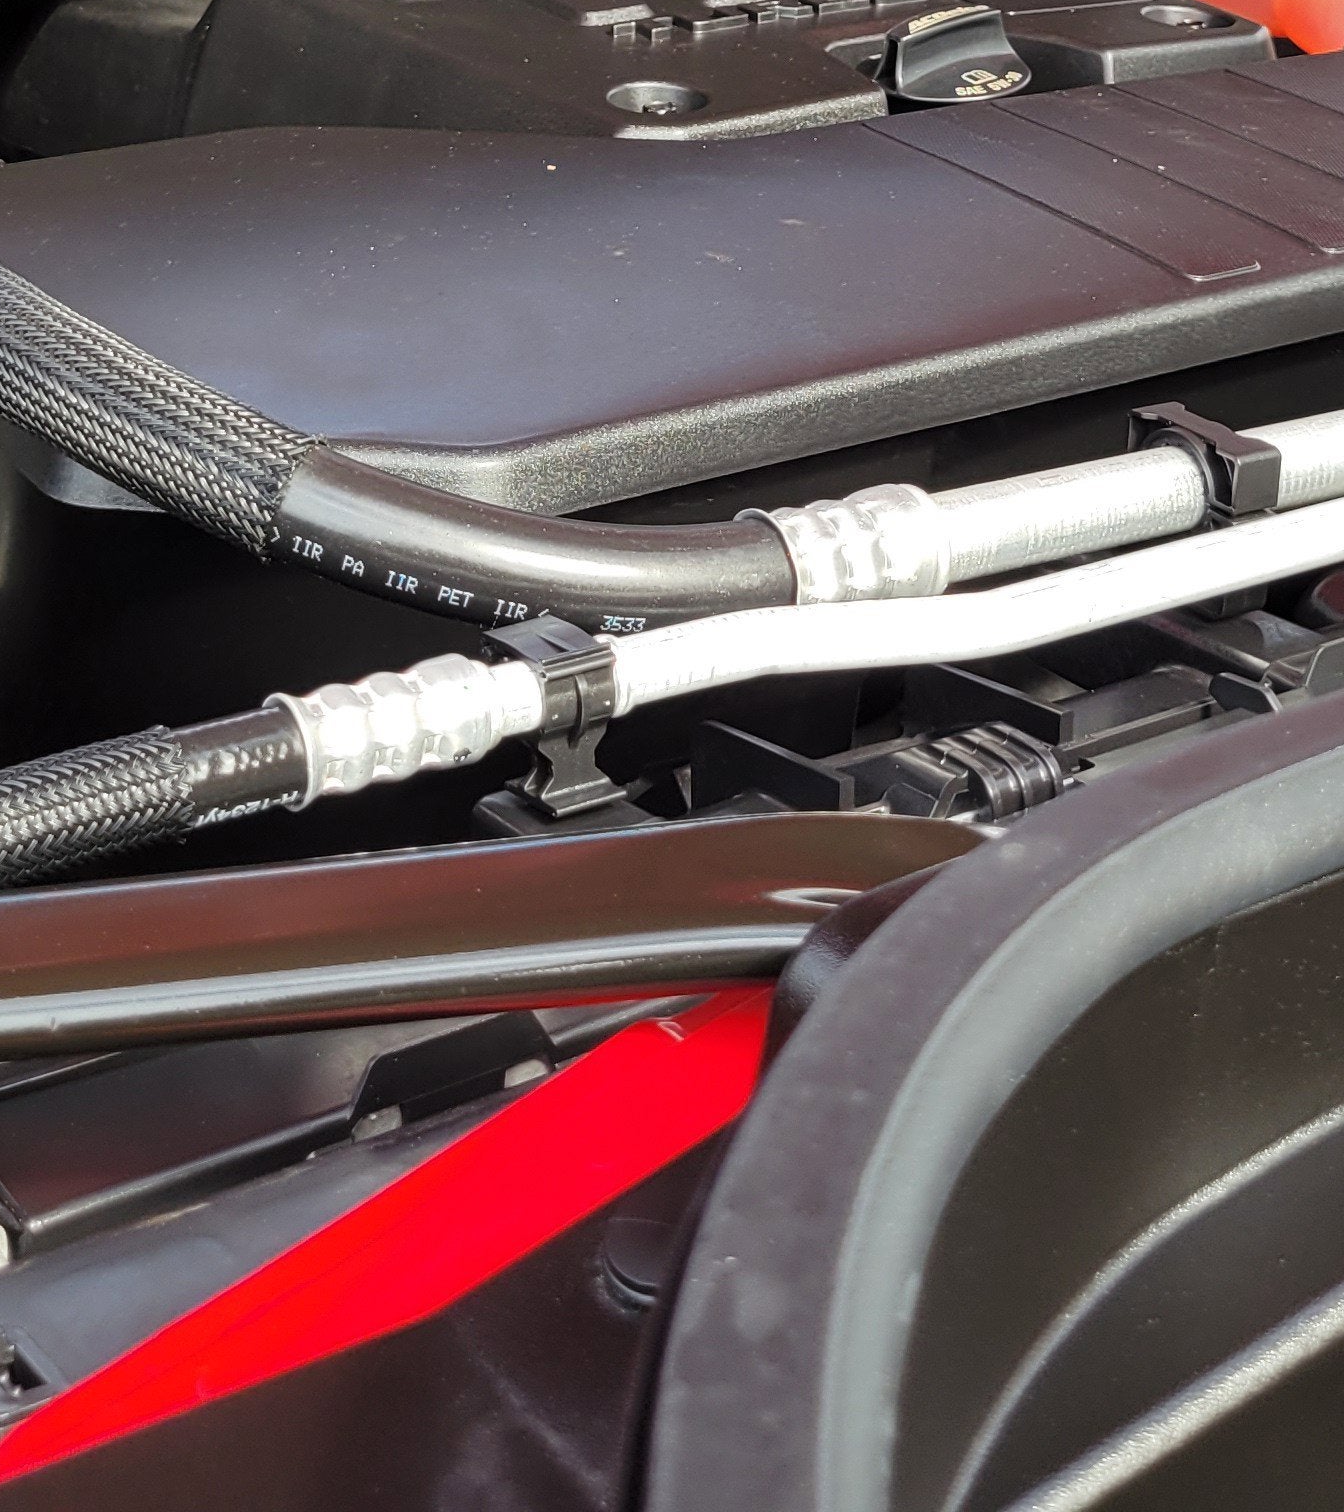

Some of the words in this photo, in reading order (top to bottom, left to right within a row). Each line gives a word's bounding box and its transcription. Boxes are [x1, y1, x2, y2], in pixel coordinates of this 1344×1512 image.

[954, 84, 988, 97] SAE
[292, 535, 324, 562] IIR
[341, 554, 365, 578] PA
[384, 570, 419, 595] IIR
[437, 585, 475, 609] PET
[492, 598, 529, 621] IIR
[599, 614, 647, 633] 3533
